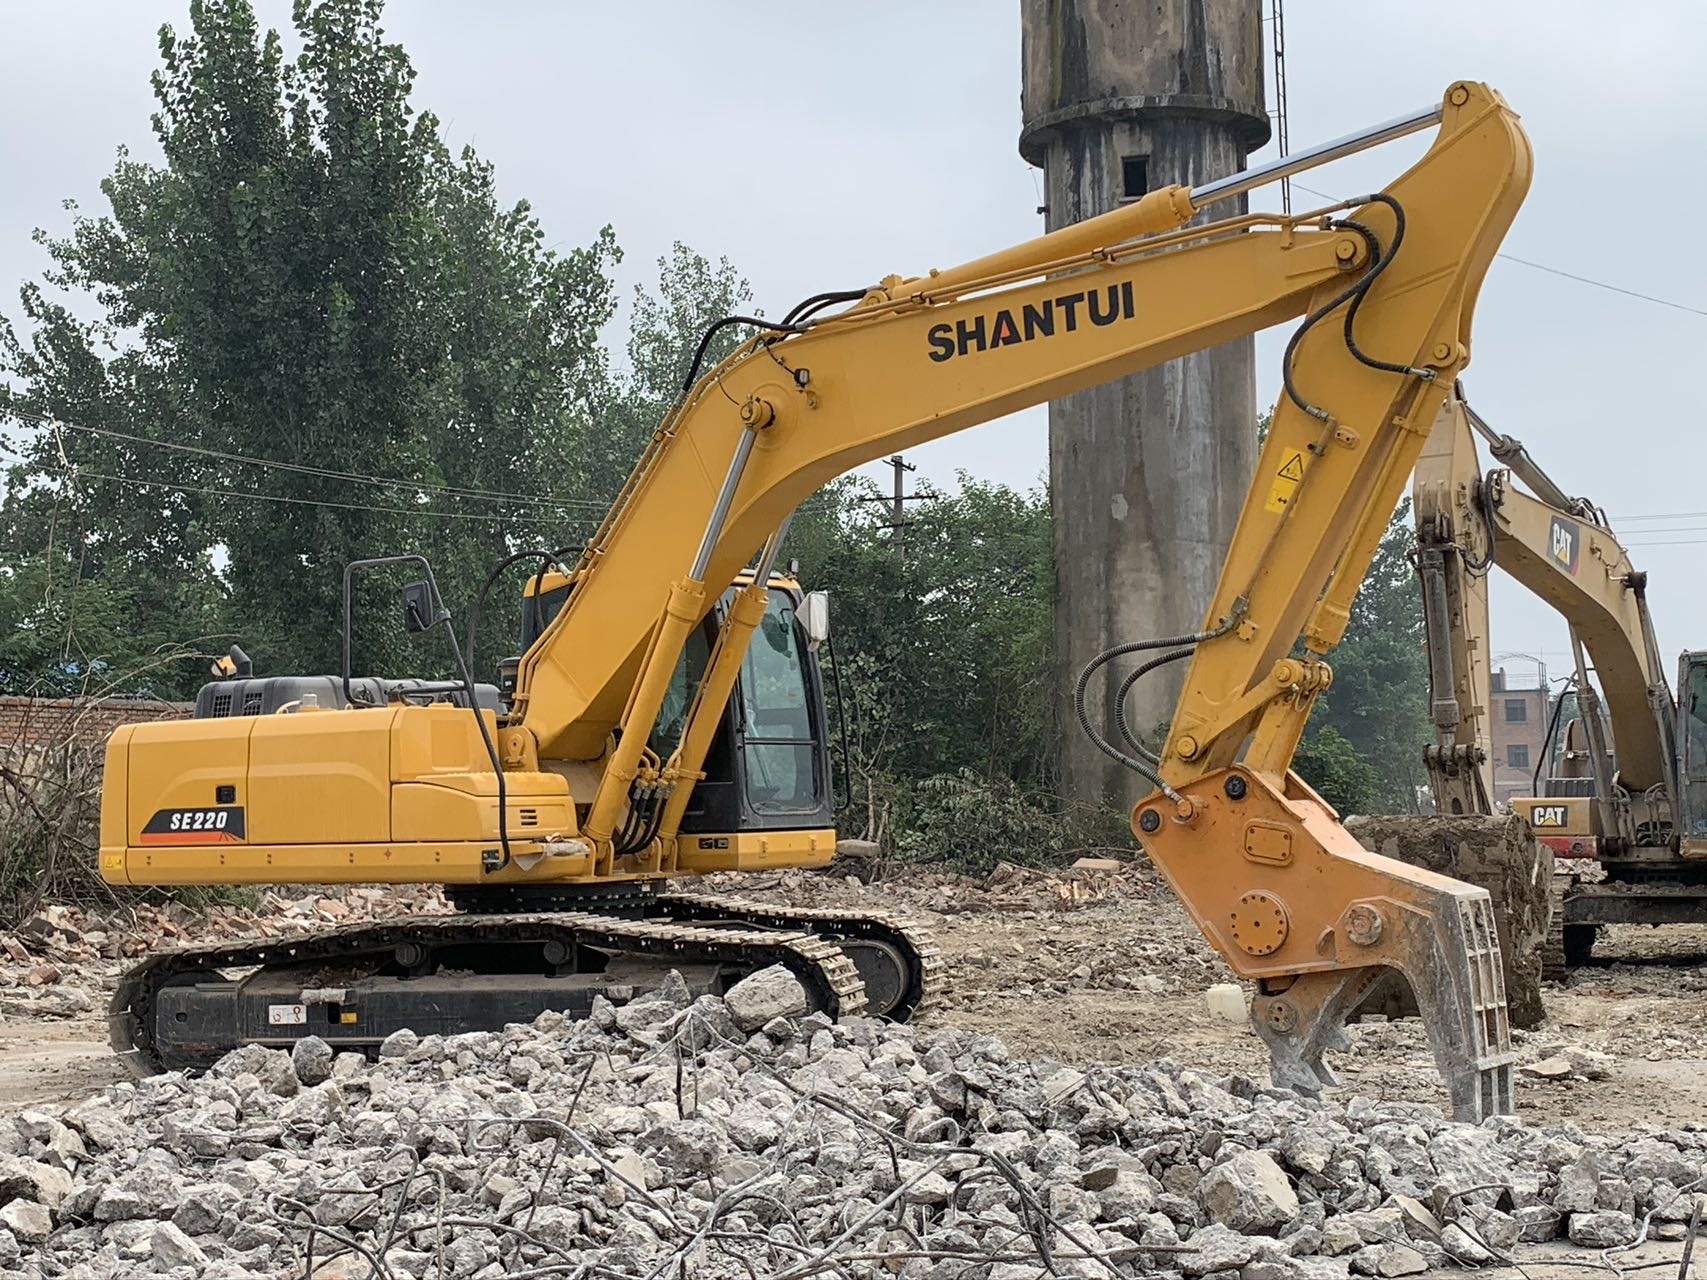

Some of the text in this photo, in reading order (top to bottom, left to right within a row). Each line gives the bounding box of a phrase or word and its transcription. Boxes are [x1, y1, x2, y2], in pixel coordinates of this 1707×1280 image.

[927, 280, 1136, 363] SHANTUI
[1552, 523, 1572, 566] CAT
[170, 811, 228, 830] SE220
[1534, 807, 1565, 826] CAT
